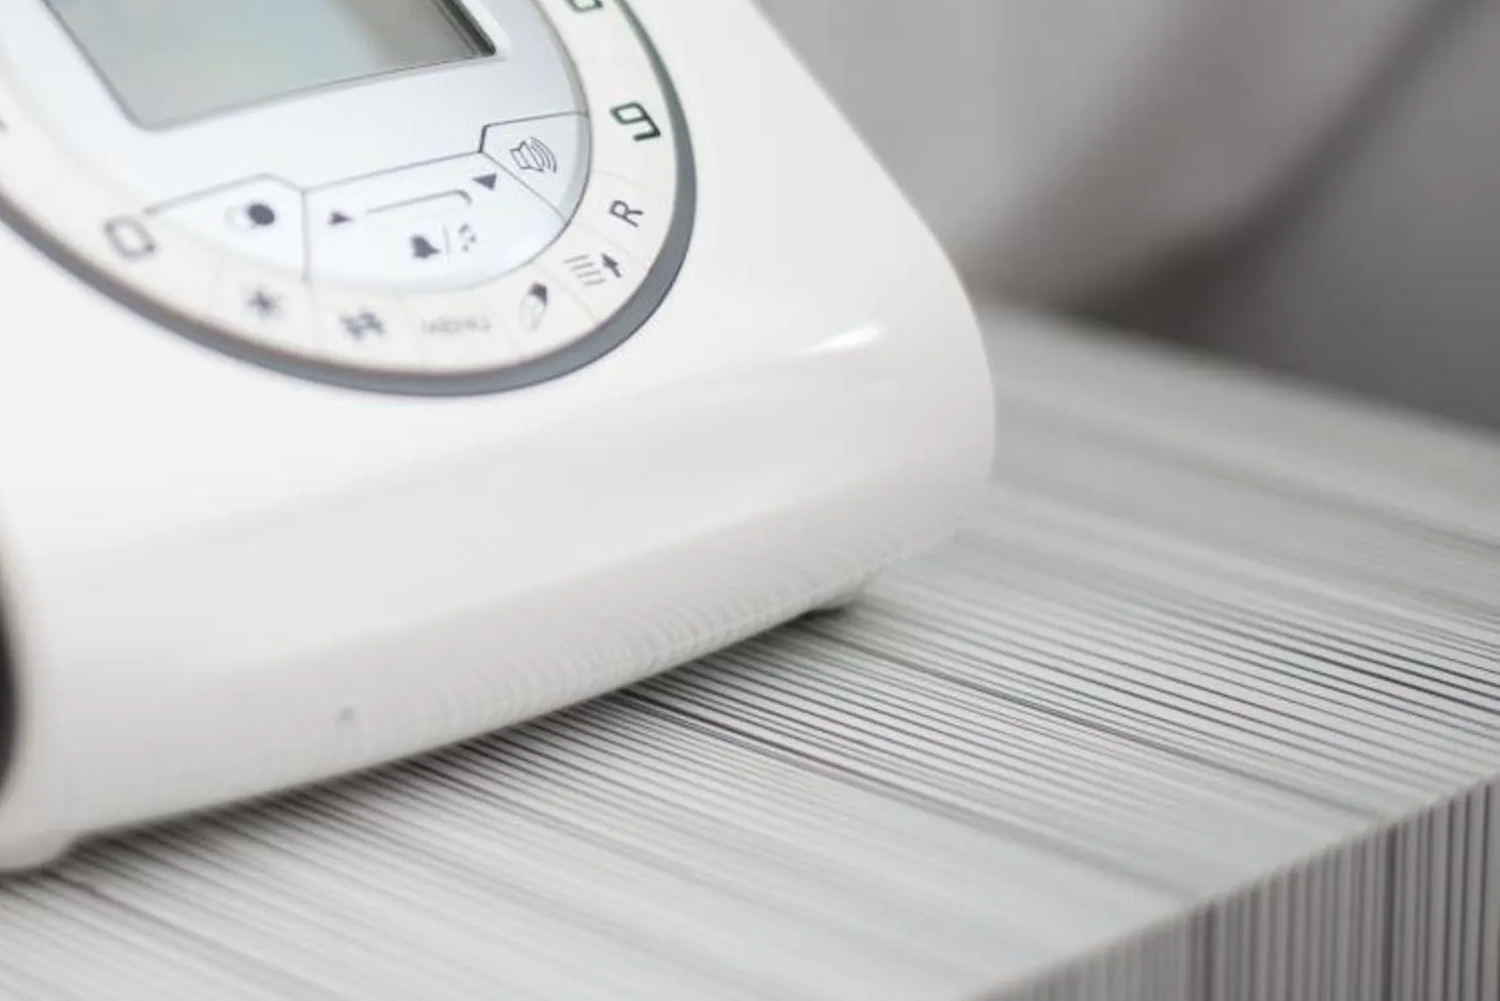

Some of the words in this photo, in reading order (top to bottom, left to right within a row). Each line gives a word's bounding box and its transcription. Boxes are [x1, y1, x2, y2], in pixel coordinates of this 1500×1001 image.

[609, 101, 662, 142] 9
[608, 199, 644, 228] R
[102, 216, 157, 261] 0
